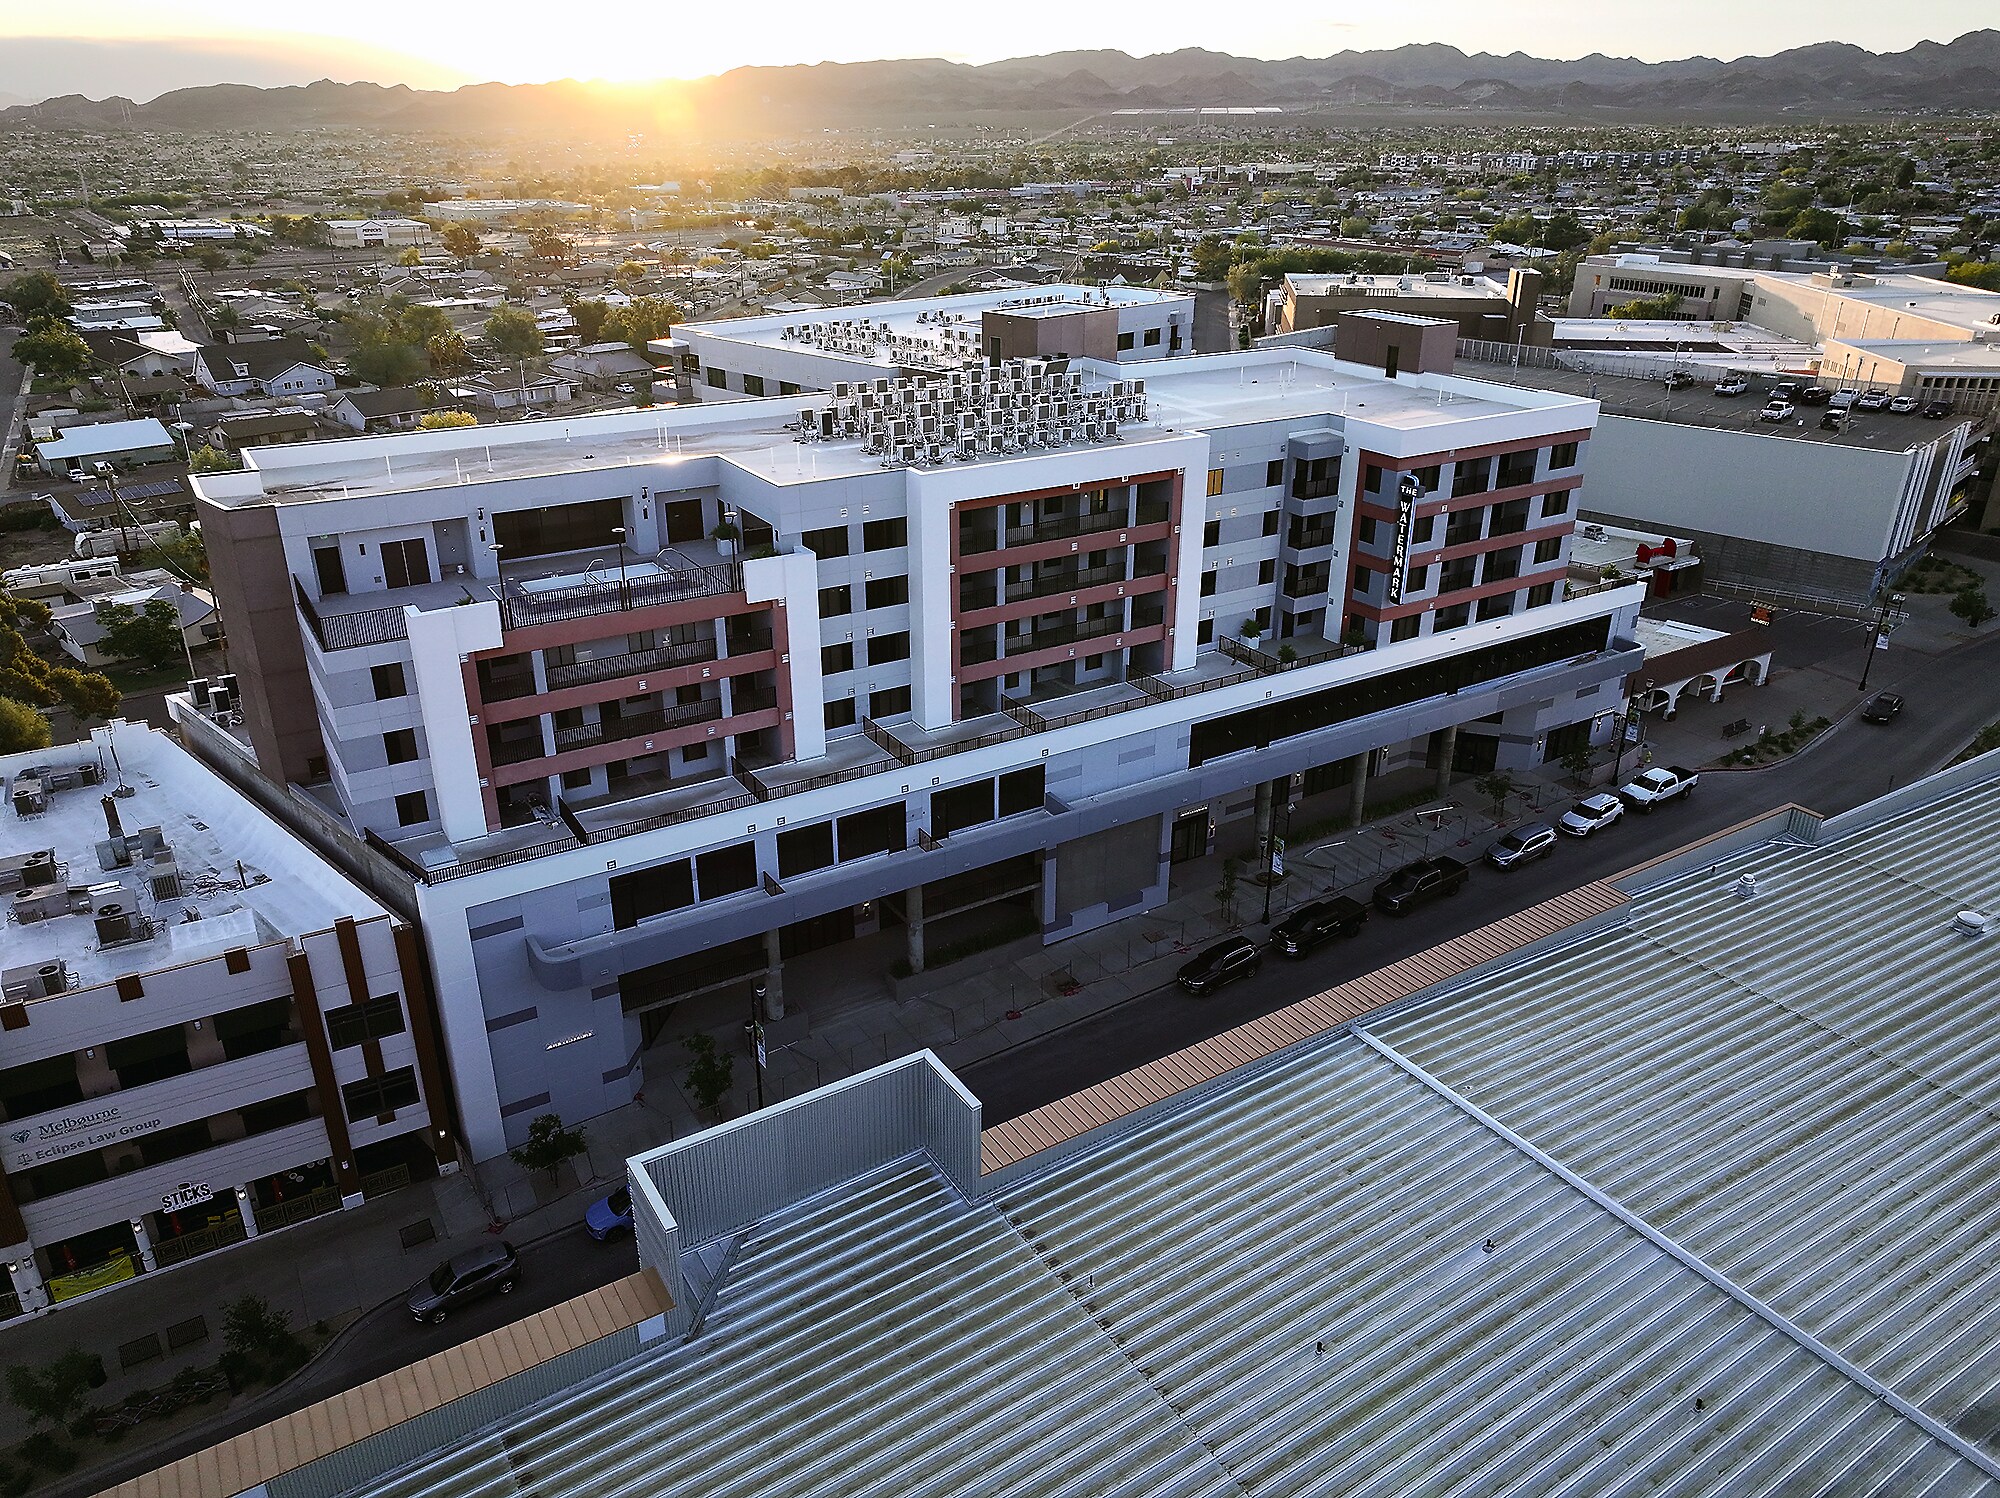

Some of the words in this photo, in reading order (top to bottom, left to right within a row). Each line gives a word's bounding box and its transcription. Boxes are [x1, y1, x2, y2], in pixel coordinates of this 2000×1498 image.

[1400, 485, 1418, 497] THE
[1390, 500, 1411, 598] WATERMARK
[35, 1139, 85, 1160] Eclipse
[88, 1130, 116, 1145] Law
[119, 1118, 161, 1137] Group
[161, 1184, 212, 1208] STICKS
